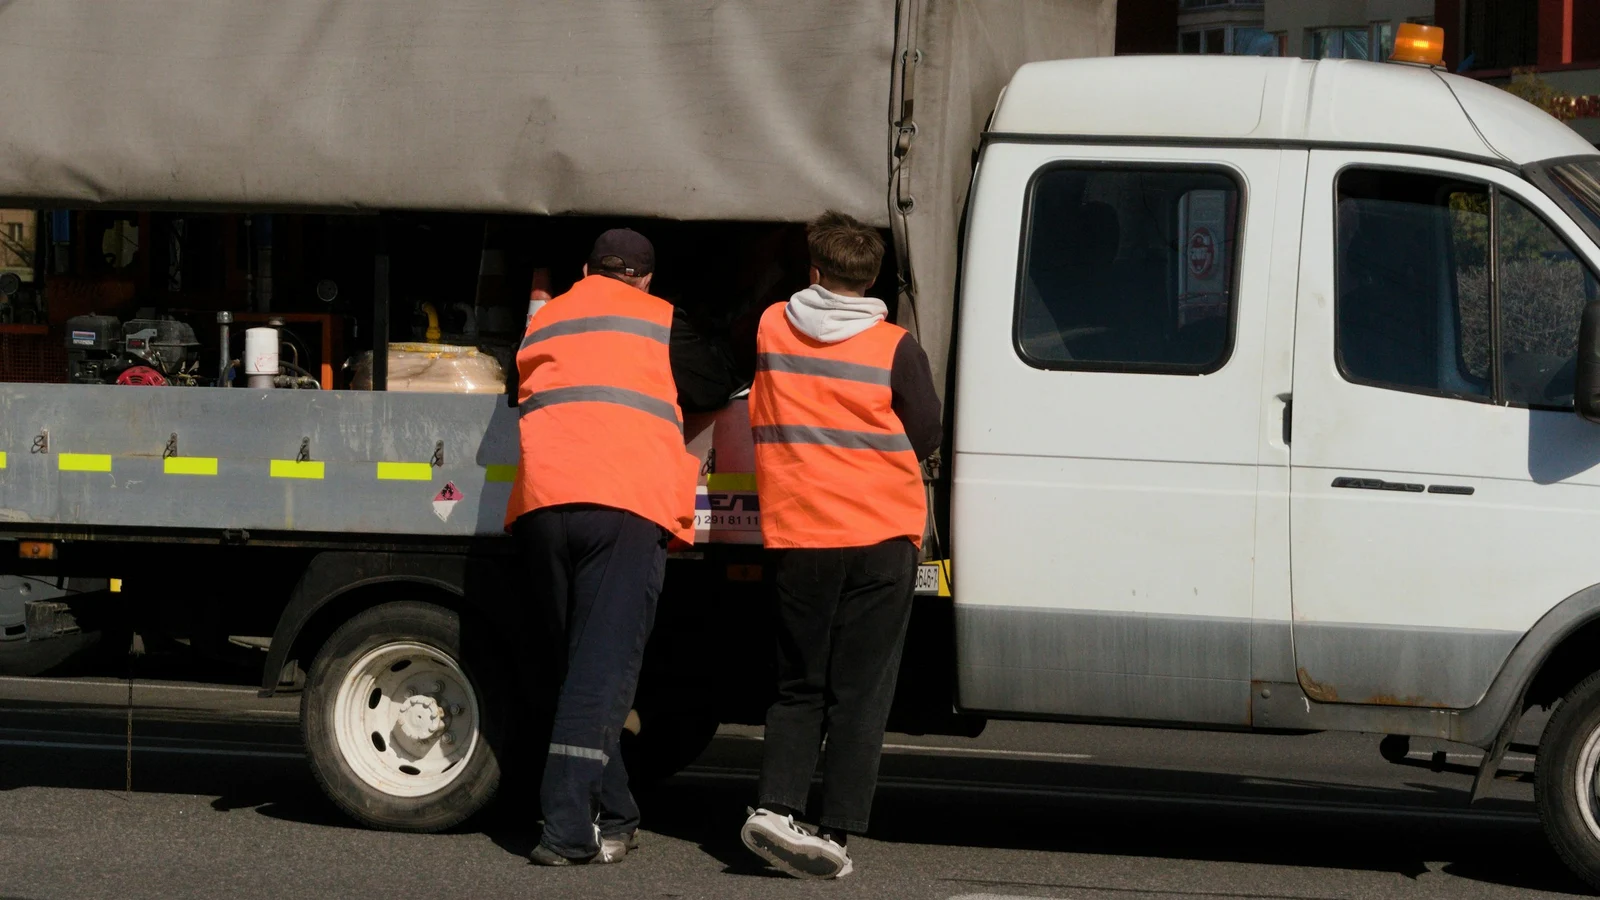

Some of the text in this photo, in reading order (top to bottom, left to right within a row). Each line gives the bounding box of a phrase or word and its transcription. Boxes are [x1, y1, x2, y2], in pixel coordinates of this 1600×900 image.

[704, 515, 724, 525] 291
[728, 515, 741, 525] 81
[747, 515, 758, 525] 11
